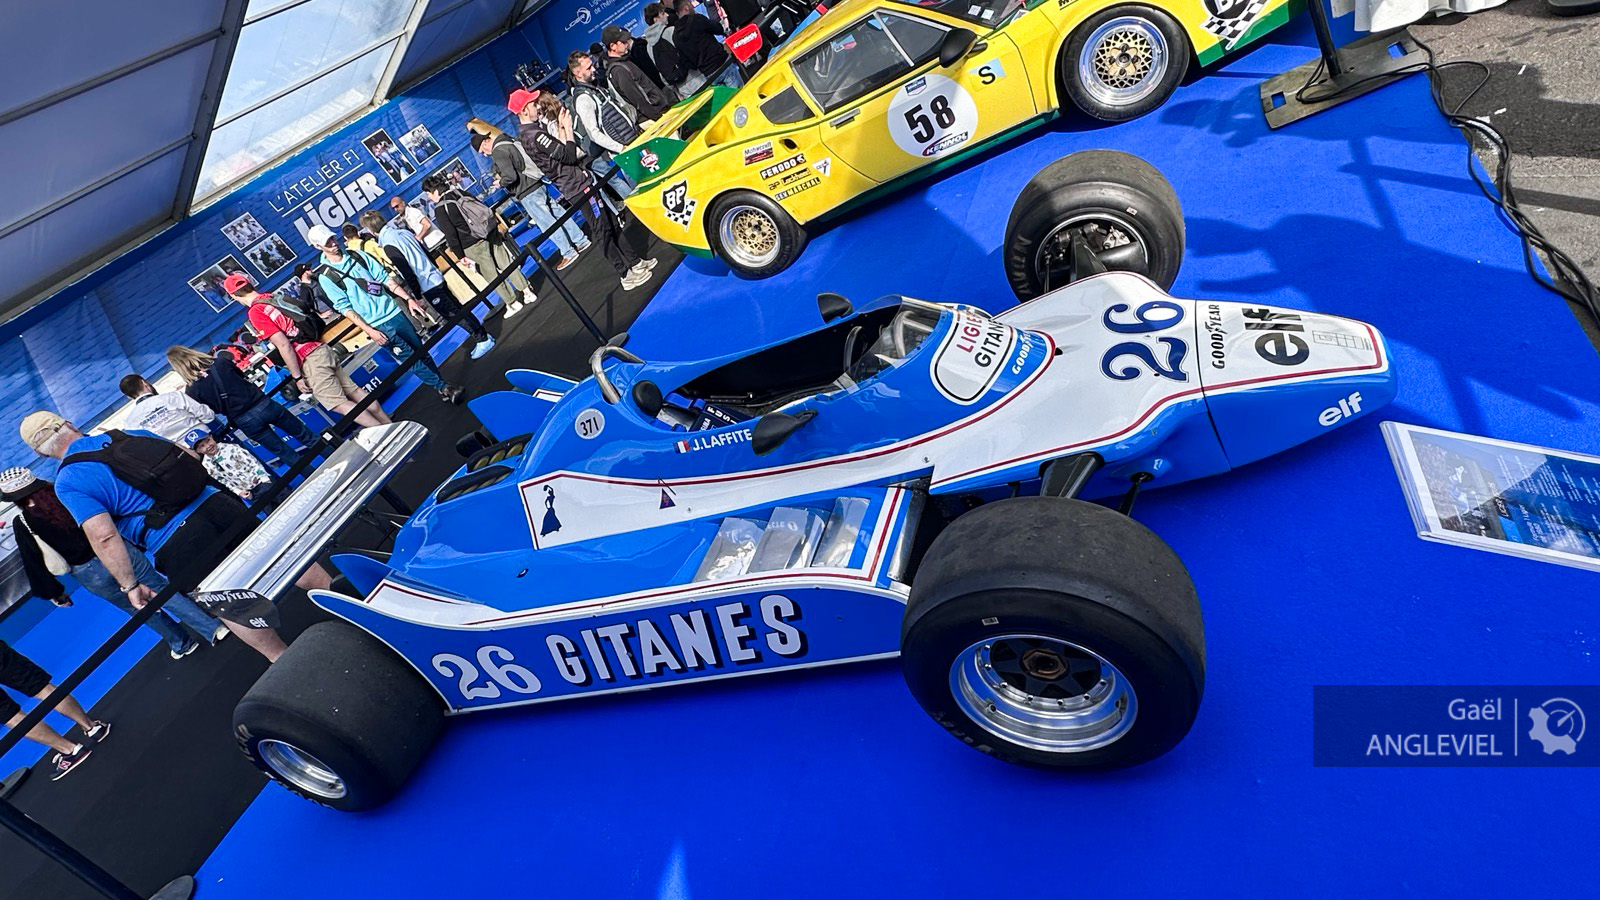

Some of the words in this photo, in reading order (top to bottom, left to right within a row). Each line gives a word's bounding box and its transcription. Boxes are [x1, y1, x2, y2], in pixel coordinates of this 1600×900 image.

[978, 65, 996, 85] S
[904, 94, 956, 144] 58
[744, 141, 772, 155] Motorcraft
[926, 131, 968, 155] KENNOL
[268, 159, 344, 212] L'ATELIER
[342, 149, 360, 165] F1
[761, 157, 797, 180] FERODO
[665, 185, 686, 210] BP
[1100, 300, 1190, 384] 26
[1205, 304, 1228, 369] GOODYEAR
[1242, 308, 1310, 366] elf
[1318, 391, 1363, 427] elf
[579, 416, 600, 436] 371
[692, 428, 753, 451] J.LAFFITE
[249, 617, 269, 629] elf
[545, 594, 803, 686] GITANES
[431, 645, 542, 700] 26
